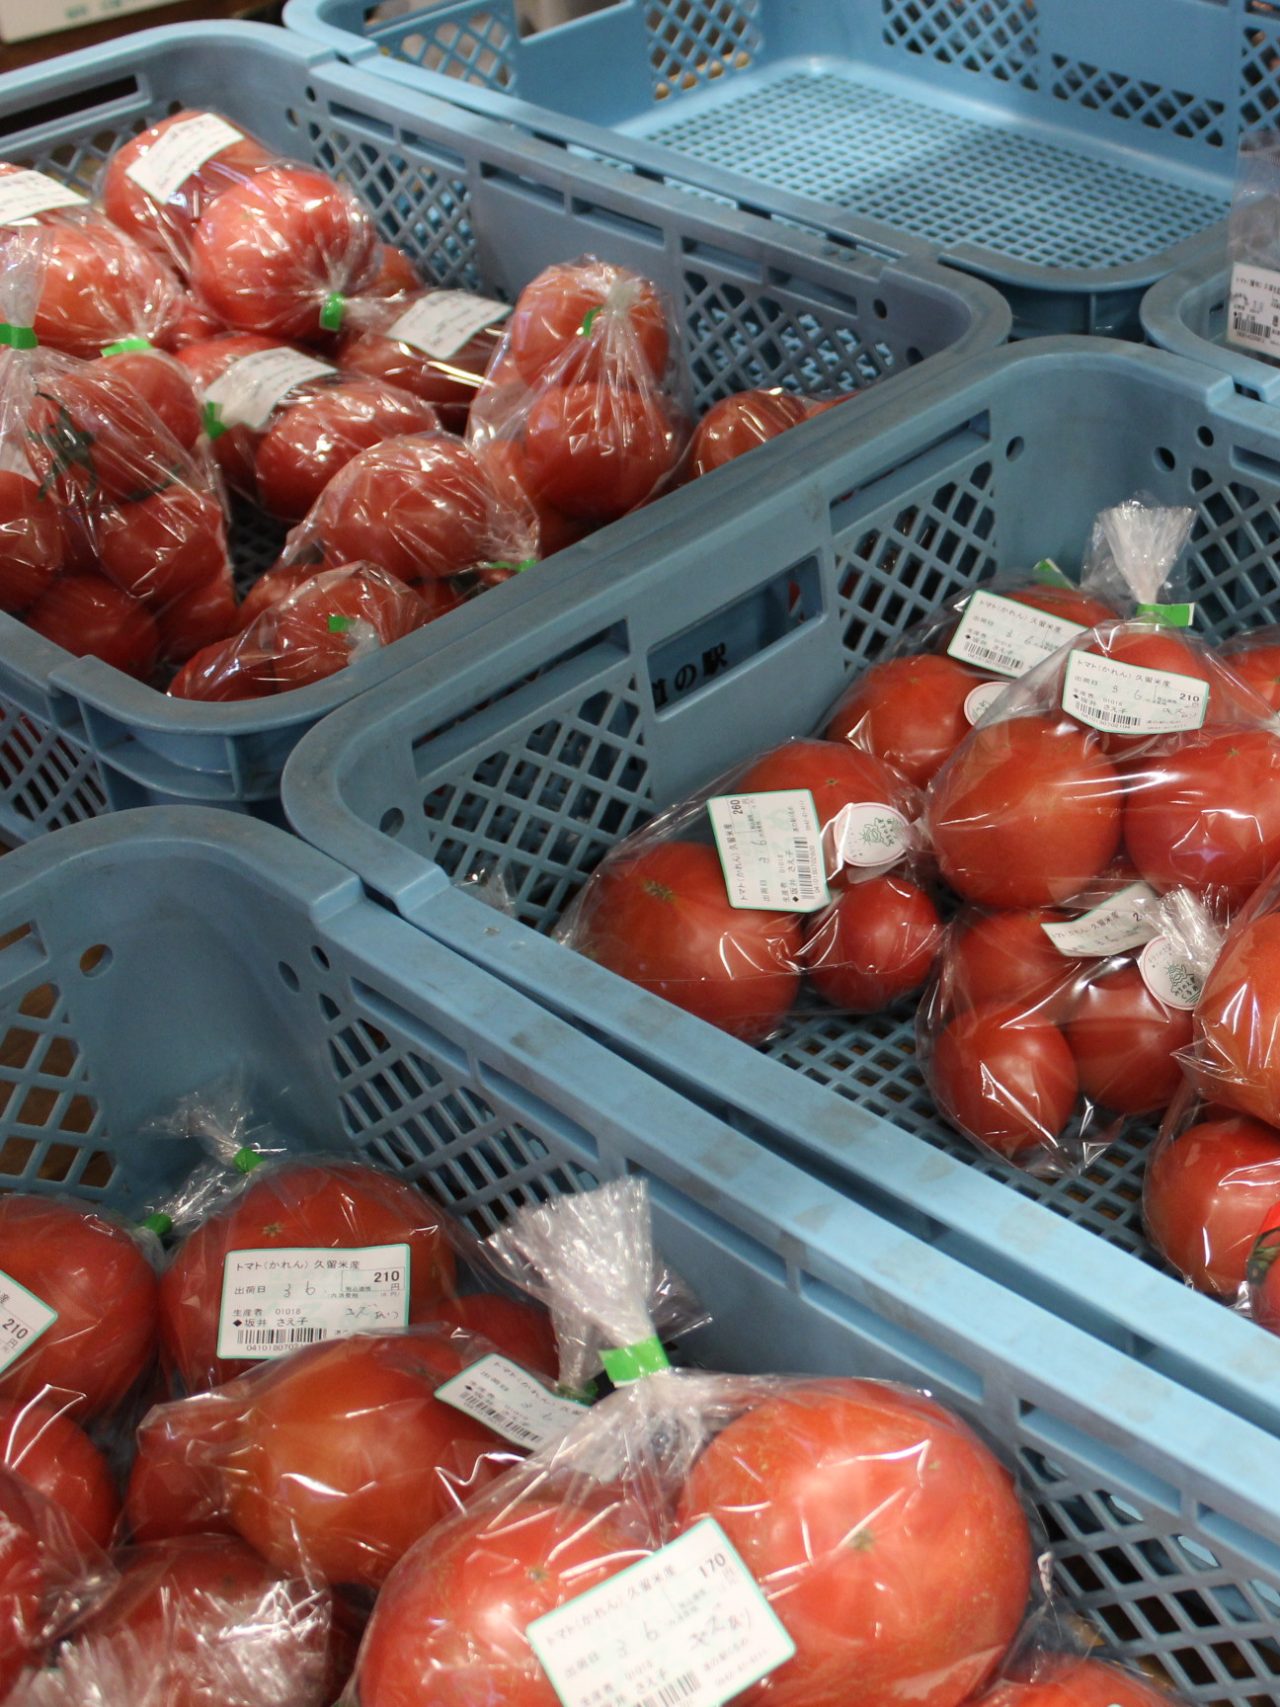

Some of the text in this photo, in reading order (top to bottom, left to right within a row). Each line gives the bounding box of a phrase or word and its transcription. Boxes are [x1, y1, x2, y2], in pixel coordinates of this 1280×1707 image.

[1179, 692, 1200, 702] 210
[732, 799, 744, 815] 260
[236, 1260, 360, 1271] トマト(かれん) 久留米産
[235, 1281, 316, 1298] 出荷日 3 6
[374, 1271, 400, 1291] 210 円
[232, 1308, 263, 1316] 生産者
[2, 1318, 28, 1340] 210
[245, 1318, 308, 1327] 坂井 さえ子
[697, 1552, 726, 1579] 170
[626, 1564, 677, 1602] 久留米産
[642, 1623, 659, 1642] 6
